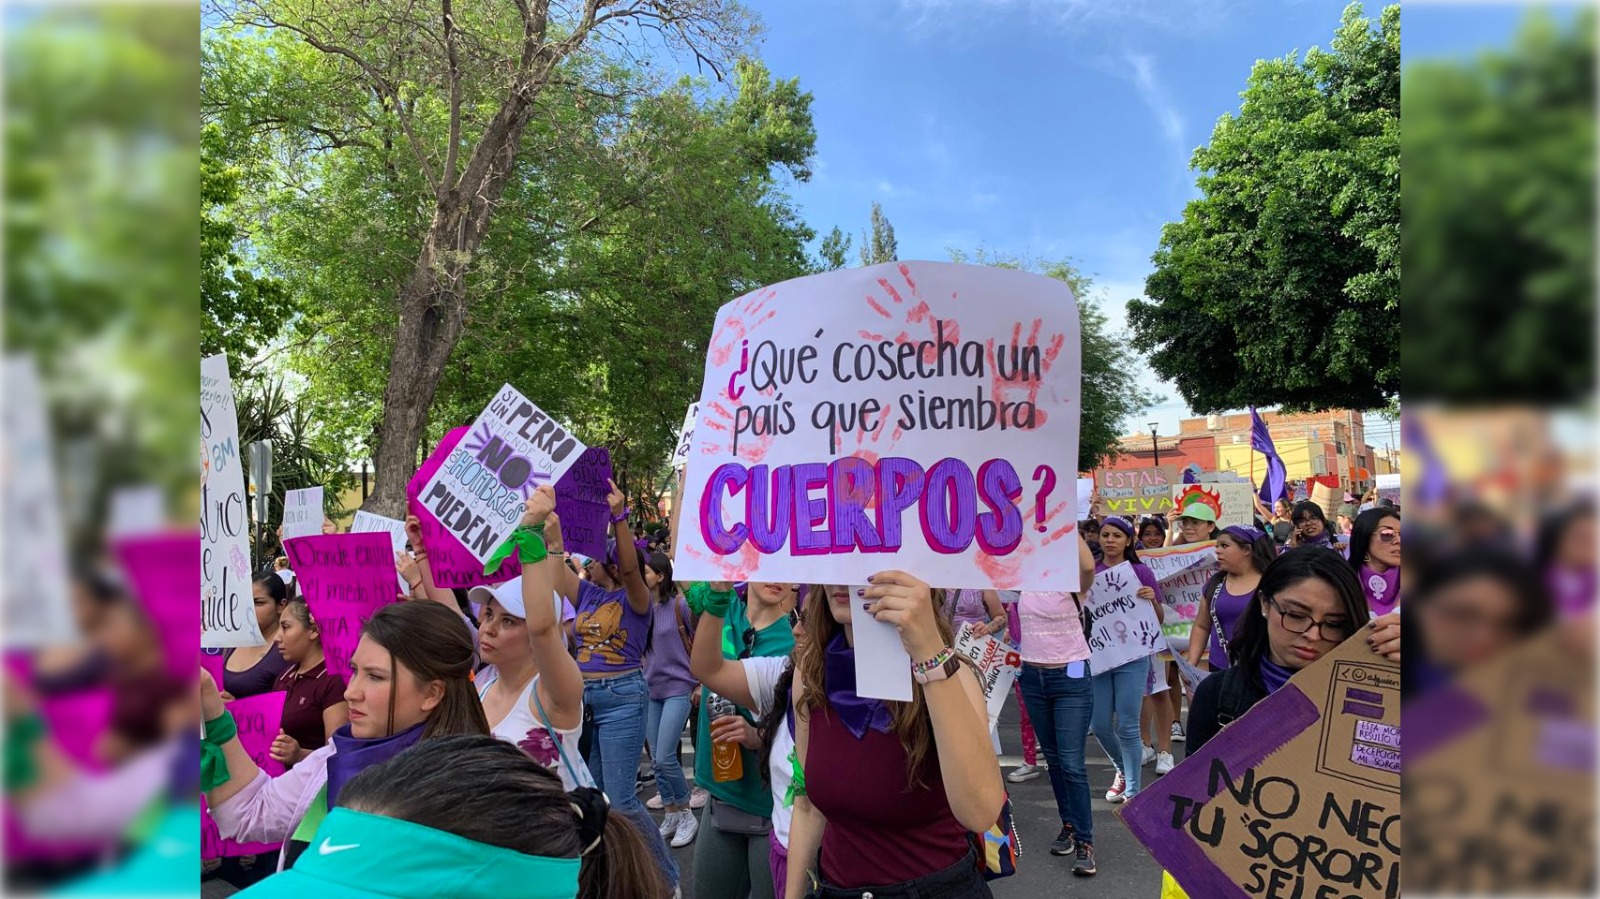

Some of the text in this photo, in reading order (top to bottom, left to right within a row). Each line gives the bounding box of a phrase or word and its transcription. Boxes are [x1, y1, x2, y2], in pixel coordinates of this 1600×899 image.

[728, 320, 1042, 400] ¿Qué cosecha un
[490, 399, 509, 419] UN
[501, 390, 519, 407] SI
[505, 401, 577, 464] PERRO
[733, 386, 1036, 456] país que siembra
[212, 437, 235, 472] 8M
[444, 447, 464, 470] LOS
[481, 412, 557, 476] ENTIENDE UN
[476, 435, 533, 490] NO
[1105, 469, 1167, 488] ESTAR
[448, 450, 528, 525] HOMBRES
[422, 479, 500, 558] PUEDEN
[1106, 496, 1173, 512] VIVA
[290, 539, 351, 568] Donde
[1089, 594, 1136, 622] ueremos
[968, 645, 981, 660] en
[1366, 674, 1400, 687] alguien
[1357, 755, 1368, 764] MI
[1207, 757, 1300, 820] NO
[1168, 793, 1226, 848] TU
